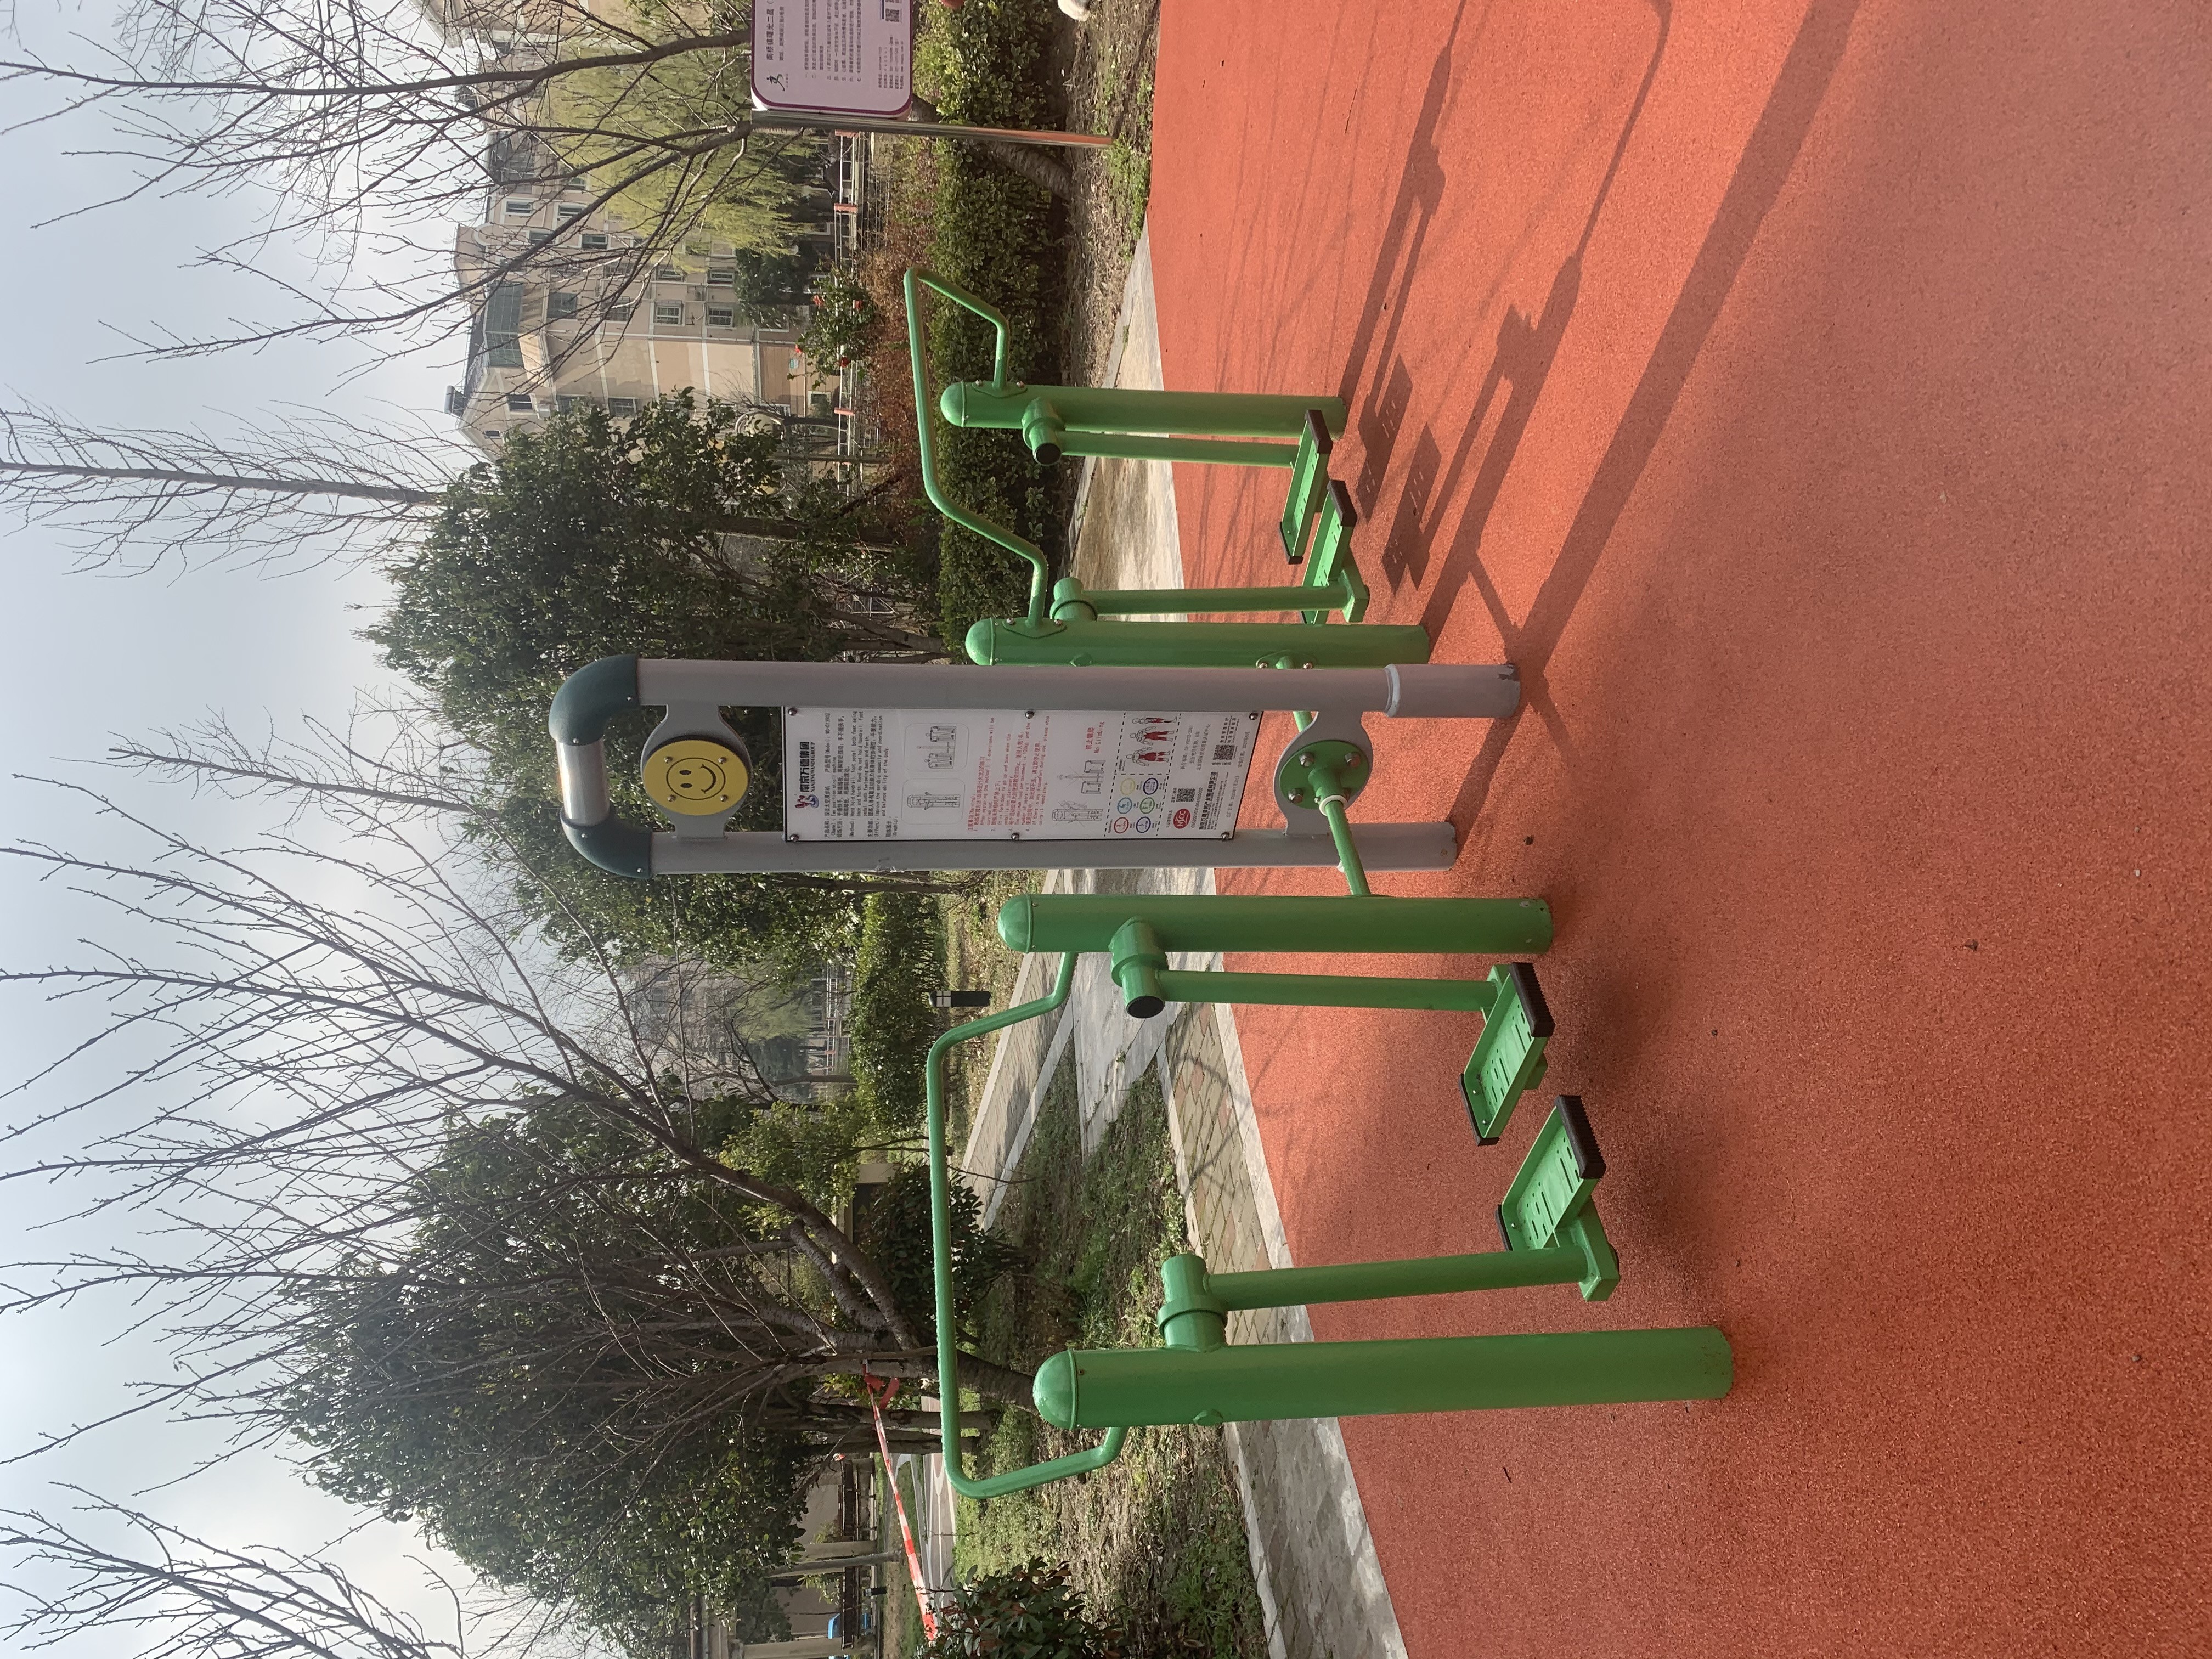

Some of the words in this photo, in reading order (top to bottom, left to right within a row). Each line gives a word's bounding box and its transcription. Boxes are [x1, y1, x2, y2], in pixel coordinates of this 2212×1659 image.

[1094, 722, 1104, 745] Climbing
[799, 742, 809, 792] 南京万德集团
[1173, 811, 1188, 827] NSCC
